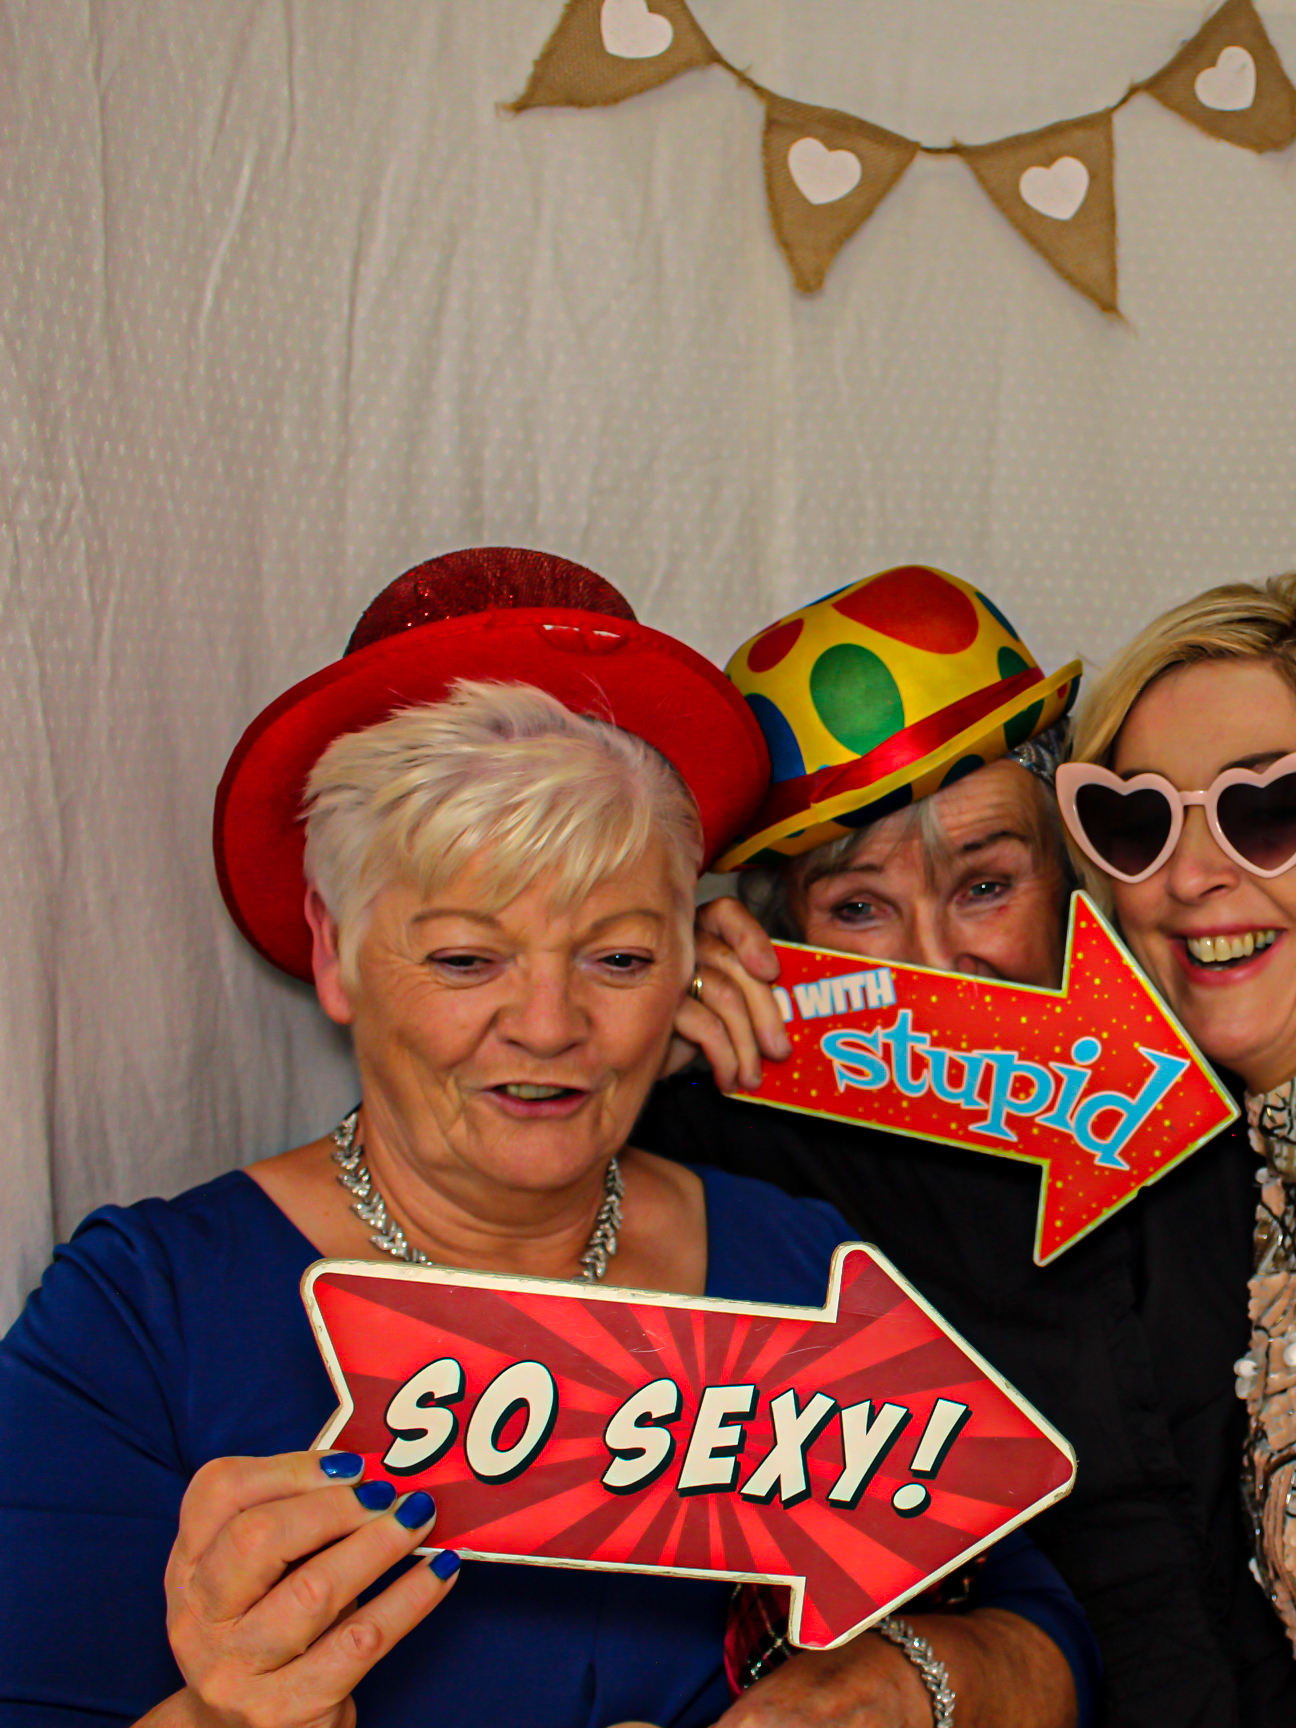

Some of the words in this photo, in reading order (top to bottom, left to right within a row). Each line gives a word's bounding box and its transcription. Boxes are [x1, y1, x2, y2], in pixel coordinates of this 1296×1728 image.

[793, 967, 896, 1019] WITH
[821, 1010, 1190, 1170] stupid
[382, 1357, 559, 1484] SO
[601, 1377, 970, 1517] SEXY!
